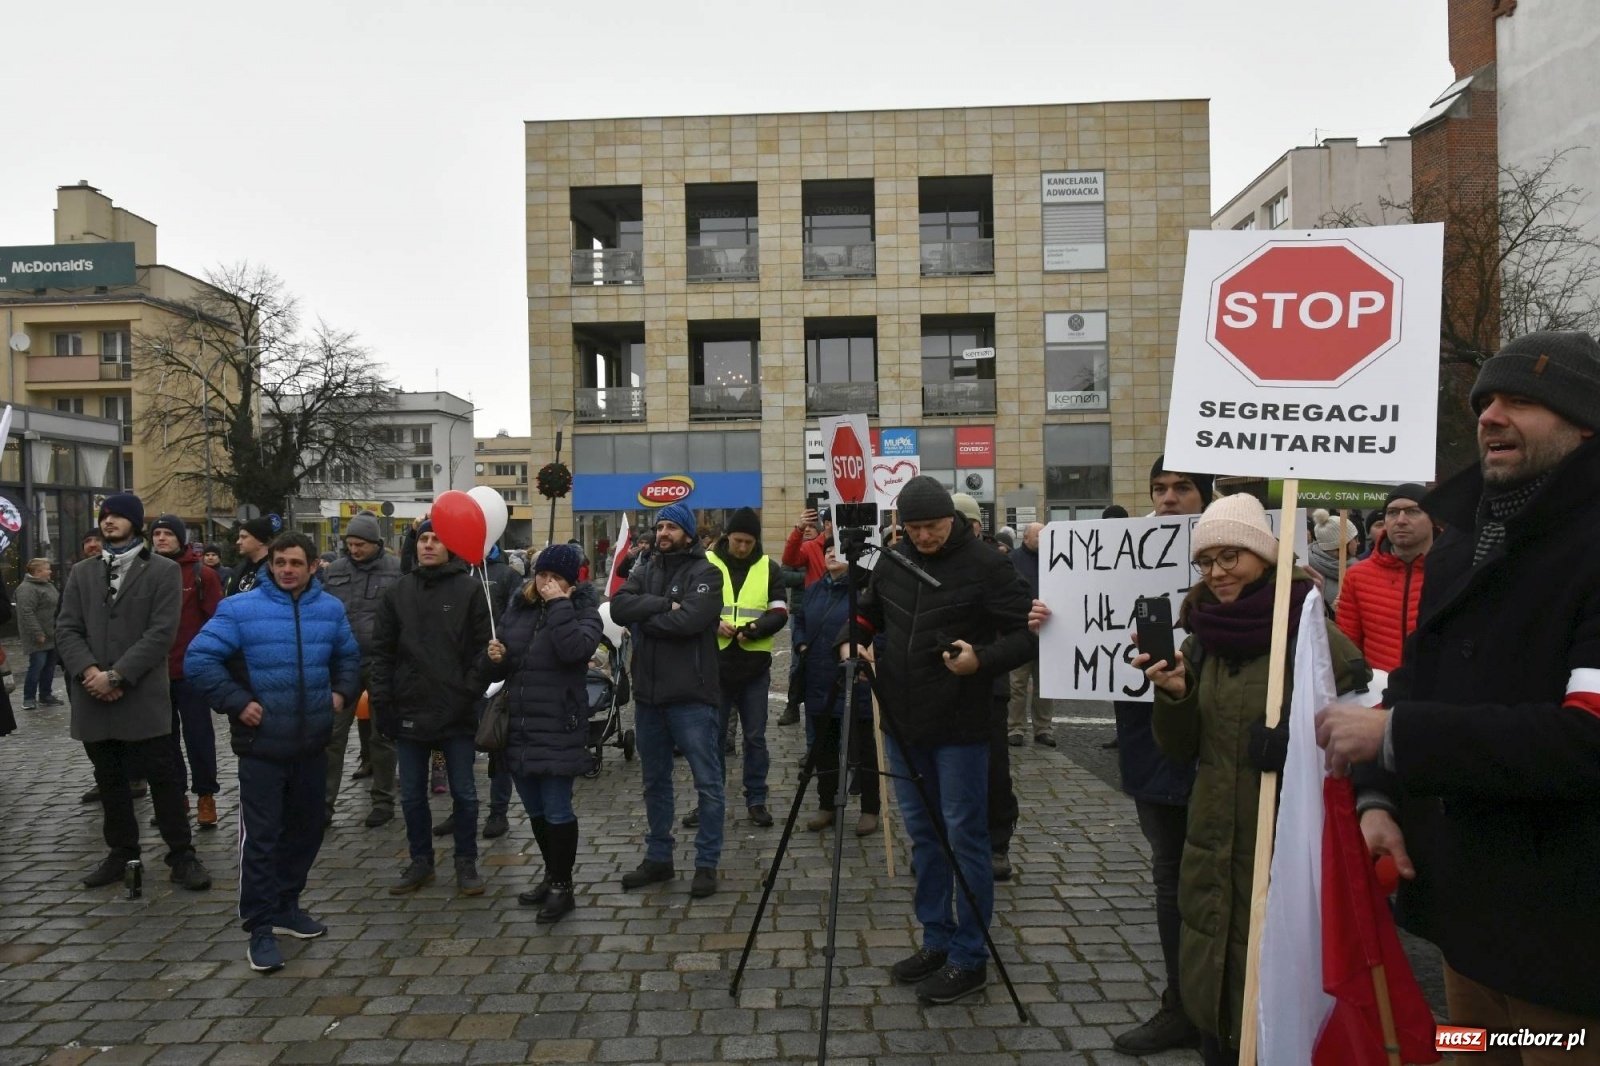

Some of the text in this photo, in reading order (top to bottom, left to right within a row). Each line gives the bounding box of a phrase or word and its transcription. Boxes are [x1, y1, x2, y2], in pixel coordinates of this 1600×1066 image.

[1047, 176, 1098, 186] KANCELARIA
[1046, 187, 1099, 197] ADWOKACKA
[11, 259, 94, 273] McDonald's
[1222, 290, 1386, 330] STOP
[1198, 400, 1400, 422] SEGREGACJI
[1195, 430, 1396, 454] SANITARNEJ
[832, 455, 864, 480] STOP
[646, 486, 686, 497] PEPCO
[1334, 492, 1360, 500] STAN
